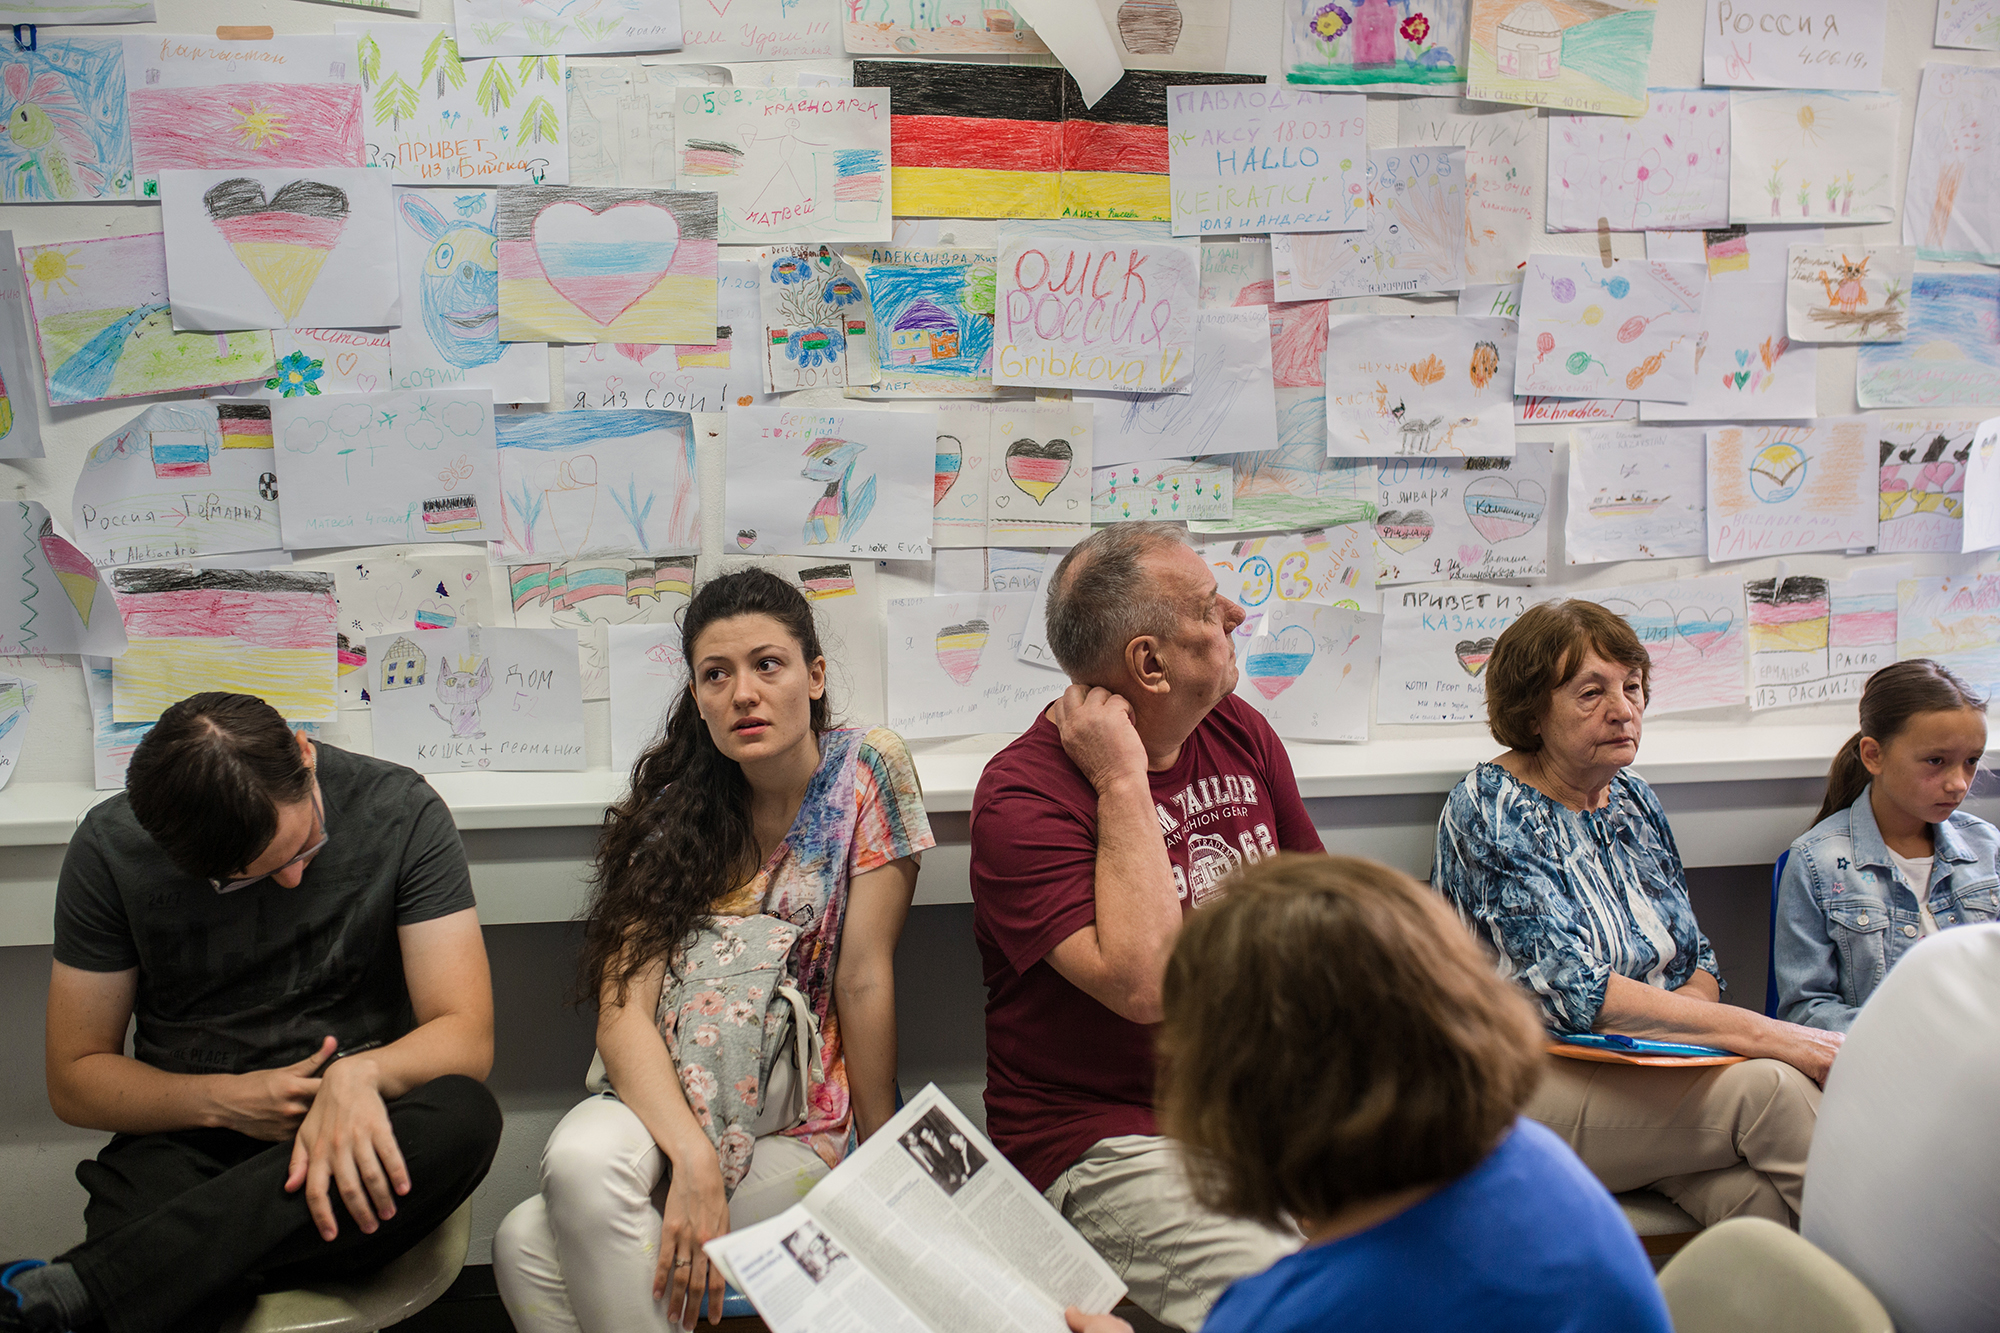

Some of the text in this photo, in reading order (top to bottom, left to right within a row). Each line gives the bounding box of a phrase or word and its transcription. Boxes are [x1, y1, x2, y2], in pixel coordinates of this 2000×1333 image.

[1524, 91, 1549, 105] KAZ
[398, 138, 489, 167] ПРИВЕТ
[1216, 145, 1320, 176] HALLO
[871, 248, 968, 267] АЛЕКСАНДРА
[1014, 248, 1151, 303] ОМСК
[1006, 289, 1172, 350] РОССИЯ
[999, 345, 1145, 387] Gribkova
[792, 365, 844, 389] 2019
[573, 391, 593, 409] Я
[780, 412, 845, 426] Germany
[365, 511, 375, 525] 4
[897, 542, 924, 555] EVA
[1716, 525, 1866, 557] PAWLODAR
[126, 541, 198, 565] Aleksandra
[1314, 524, 1360, 599] Friedland
[1430, 560, 1443, 576] Я
[1402, 591, 1525, 617] ПРИВЕТ ИЗ
[1421, 612, 1519, 633] КАЗАХСТ
[1256, 636, 1299, 654] РОССИЯ
[505, 663, 554, 691] ДОМ
[1755, 687, 1779, 708] ИЗ
[416, 742, 476, 760] КОШКА
[500, 740, 583, 756] ГЕРМАНИЯ
[1169, 772, 1260, 820] TAILOR
[1222, 806, 1249, 820] GEAR
[1211, 863, 1229, 878] TM
[190, 1046, 231, 1066] PLACE
